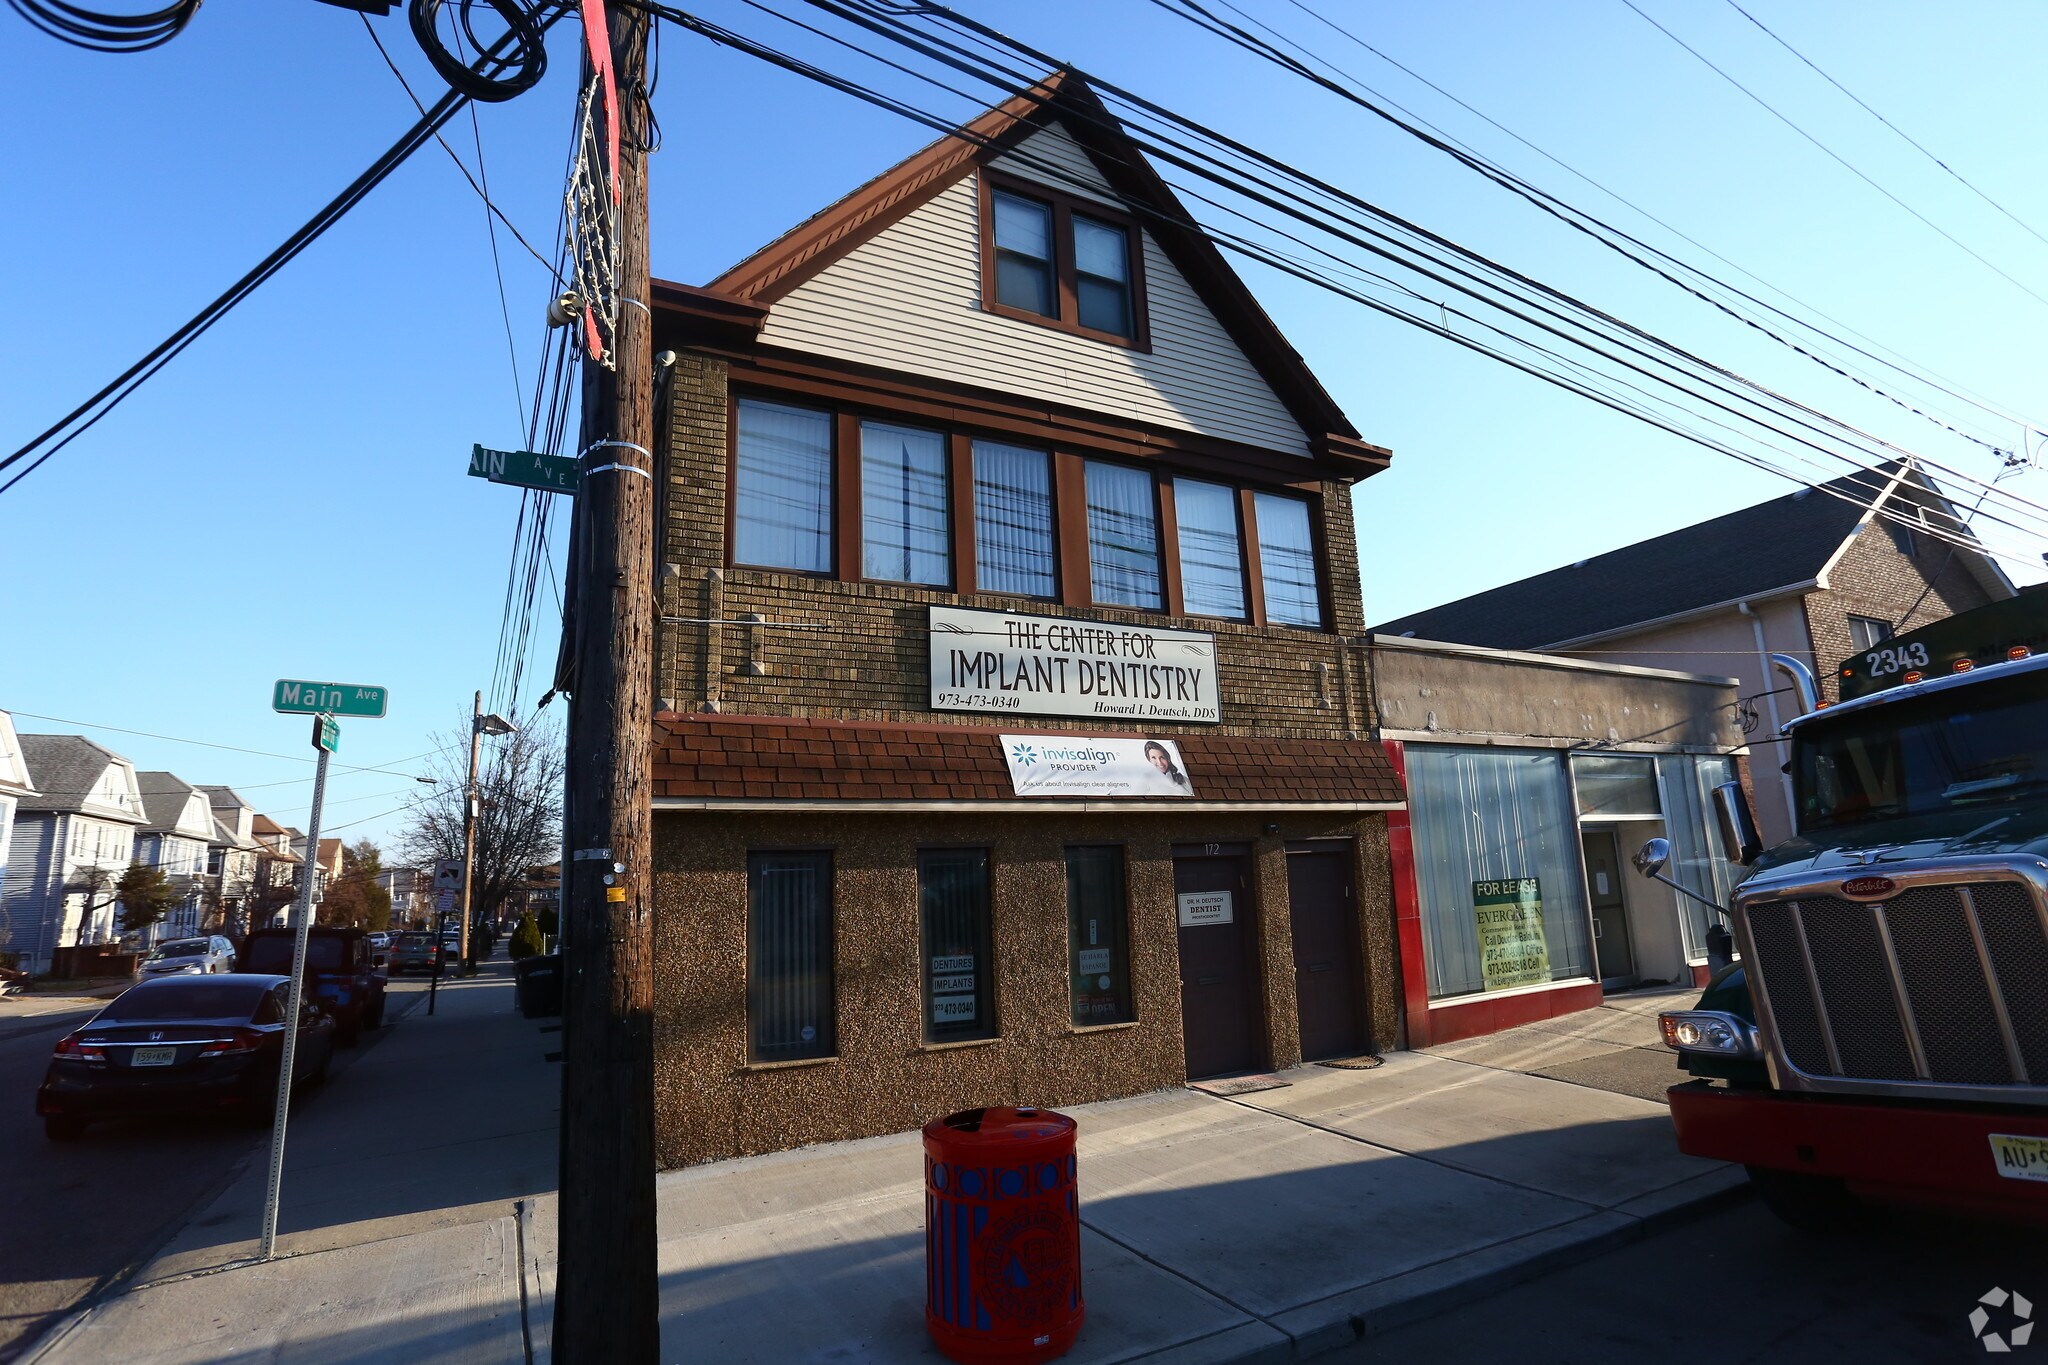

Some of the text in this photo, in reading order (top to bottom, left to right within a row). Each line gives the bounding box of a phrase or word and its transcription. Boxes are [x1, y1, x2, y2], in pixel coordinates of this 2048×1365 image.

[534, 456, 566, 485] AVE
[1004, 620, 1157, 660] THE CENTER FOR
[1866, 642, 1930, 678] 2343
[950, 649, 1202, 702] IMPLANT DENTISTRY
[281, 682, 378, 708] Main Ave
[938, 693, 1020, 709] 973-473-0340
[1094, 701, 1216, 719] Howard I. Deutsch, DDS
[1041, 746, 1116, 765] invisalign
[1050, 763, 1098, 772] PROVIDER
[1063, 780, 1091, 790] Invisalign
[1205, 843, 1220, 856] 172
[1476, 879, 1538, 896] FOR LEASE
[1846, 880, 1889, 893] Peterbilt
[1190, 905, 1222, 913] DENTIST
[1476, 906, 1543, 925] EVERGREEN
[1485, 934, 1497, 946] Call
[933, 958, 973, 970] DENTURES
[1528, 957, 1540, 970] Cell
[934, 977, 973, 990] IMPLANTS
